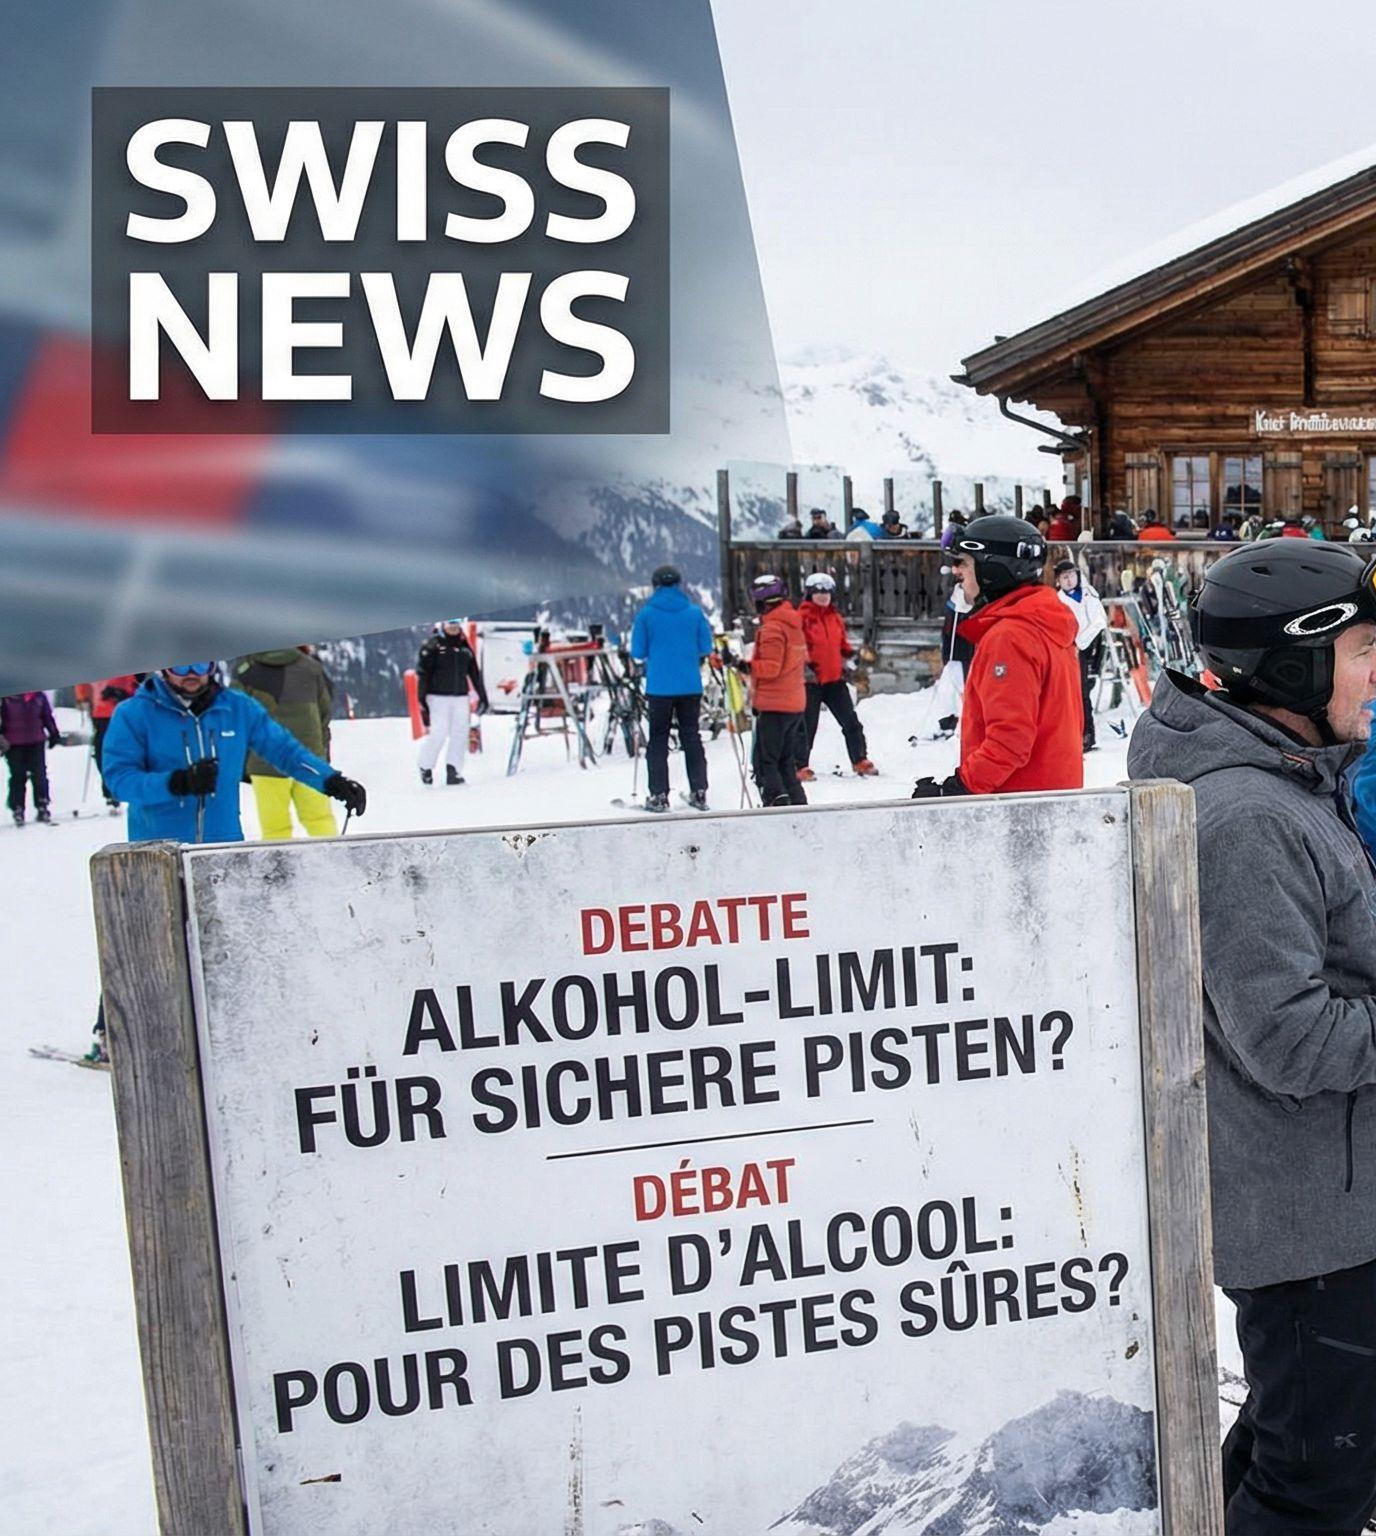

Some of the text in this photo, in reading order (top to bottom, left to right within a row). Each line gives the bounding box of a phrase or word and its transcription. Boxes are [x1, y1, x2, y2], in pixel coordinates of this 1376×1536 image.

[581, 894, 808, 955] DEBATTE
[402, 942, 975, 1056] ALKOHOL-LIMIT:
[294, 1010, 1074, 1154] FÜR SICHERE PISTEN?
[634, 1158, 793, 1221] DÉBAT
[399, 1196, 1014, 1333] LIMITE D'ALCOOL:
[272, 1252, 1129, 1434] POUR DES PISTES SÛRES?
